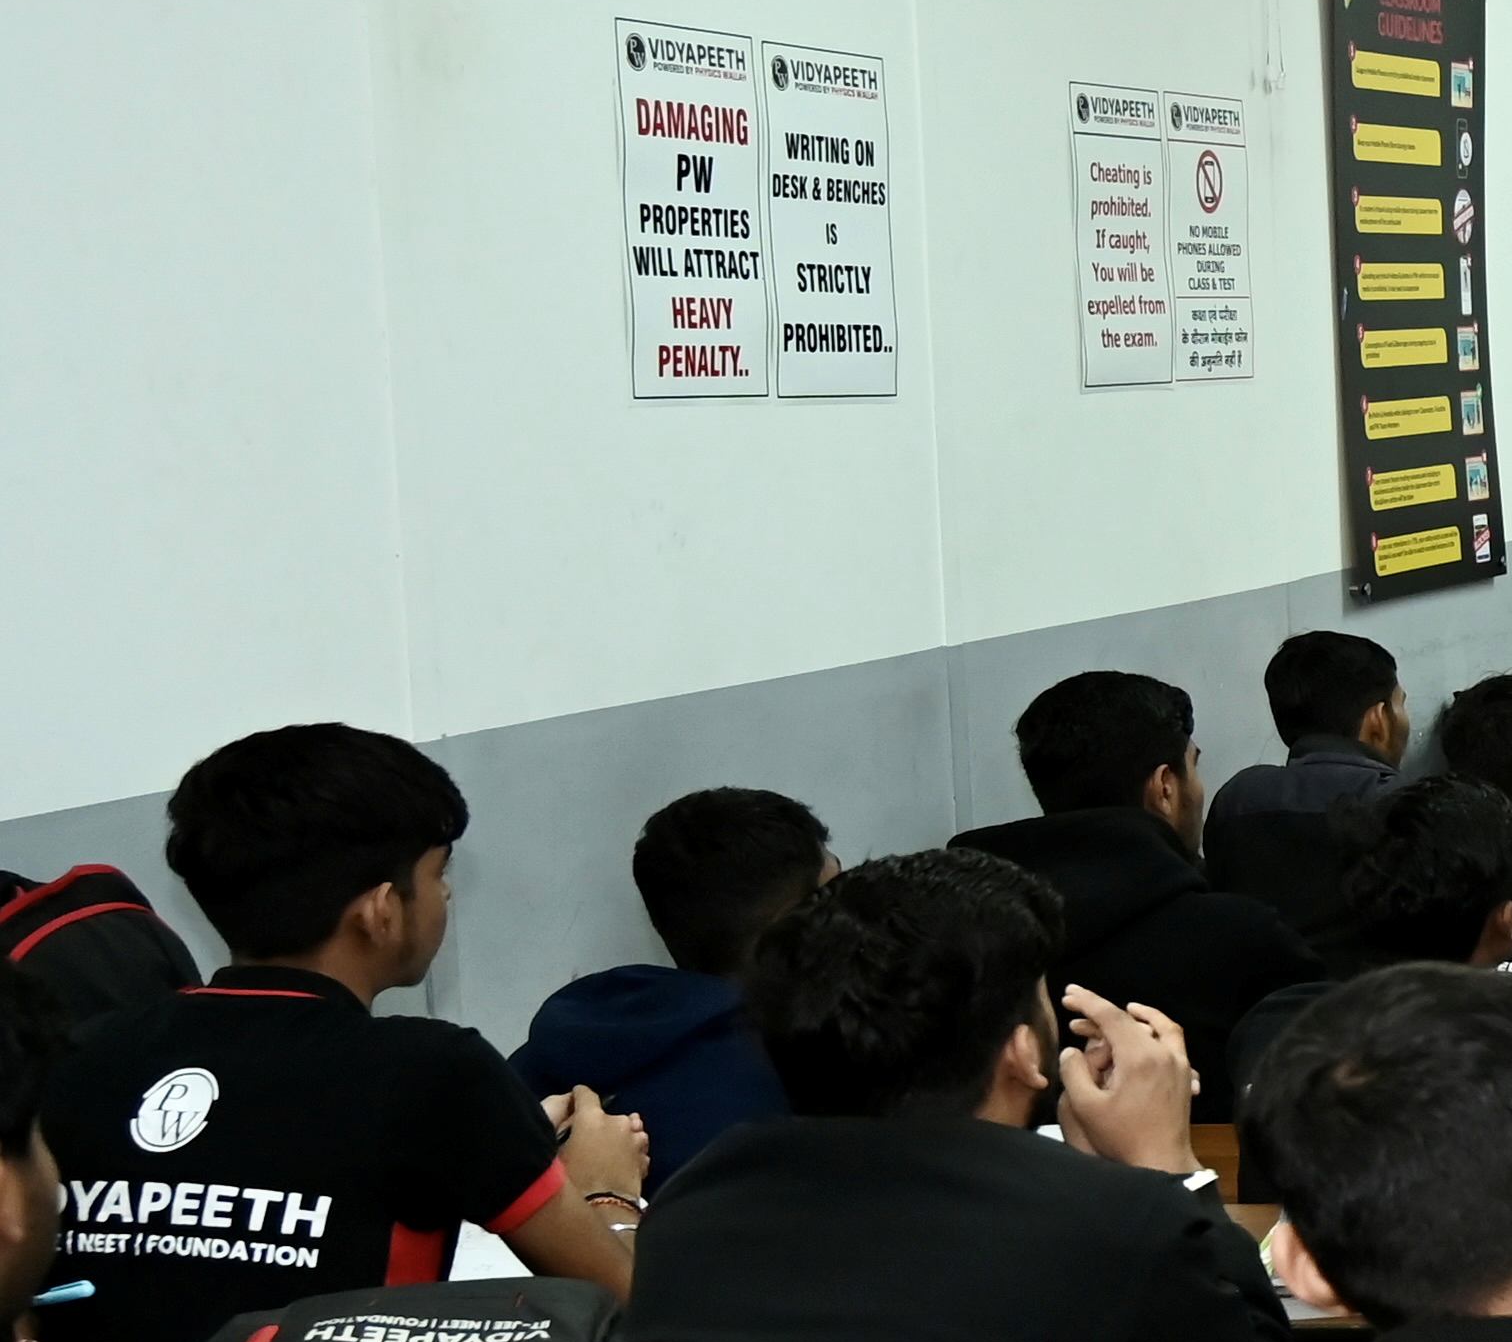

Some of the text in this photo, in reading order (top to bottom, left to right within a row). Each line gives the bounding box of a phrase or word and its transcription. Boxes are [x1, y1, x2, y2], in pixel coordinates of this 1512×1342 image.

[1378, 12, 1442, 44] GUIDELINES
[648, 37, 746, 71] VIDYAPEETH
[653, 62, 684, 74] POWERED
[684, 65, 693, 75] BY
[695, 66, 723, 79] PHYSICS
[790, 59, 878, 90] VIDYAPEETH
[636, 97, 749, 146] DAMAGING
[1091, 96, 1155, 119] VIDYAPEETH
[1183, 105, 1240, 127] VIDYAPEETH
[785, 132, 875, 167] WRITING ON
[676, 154, 714, 193] PW
[1090, 162, 1152, 189] Cheating is
[772, 173, 886, 206] DESK & BENCHES
[639, 203, 751, 239] PROPERTIES
[1091, 196, 1151, 220] prohibited.
[825, 223, 838, 245] IS
[1096, 229, 1150, 254] If caught,
[1189, 226, 1229, 239] NO MOBILE
[633, 246, 760, 280] WILL ATTRACT
[1178, 242, 1241, 256] PHONES ALLOWED
[797, 263, 872, 294] STRICTLY
[1092, 262, 1155, 282] You will be
[1197, 261, 1224, 273] DURING
[1188, 278, 1210, 290] CLASS
[1219, 278, 1235, 290] TEST
[671, 297, 733, 329] HEAVY
[1088, 295, 1166, 319] expelled from
[783, 323, 893, 353] PROHIBITED..
[1101, 328, 1158, 348] the exam.
[658, 345, 749, 378] PENALTY..
[77, 1233, 320, 1268] NEET FOUNDATION
